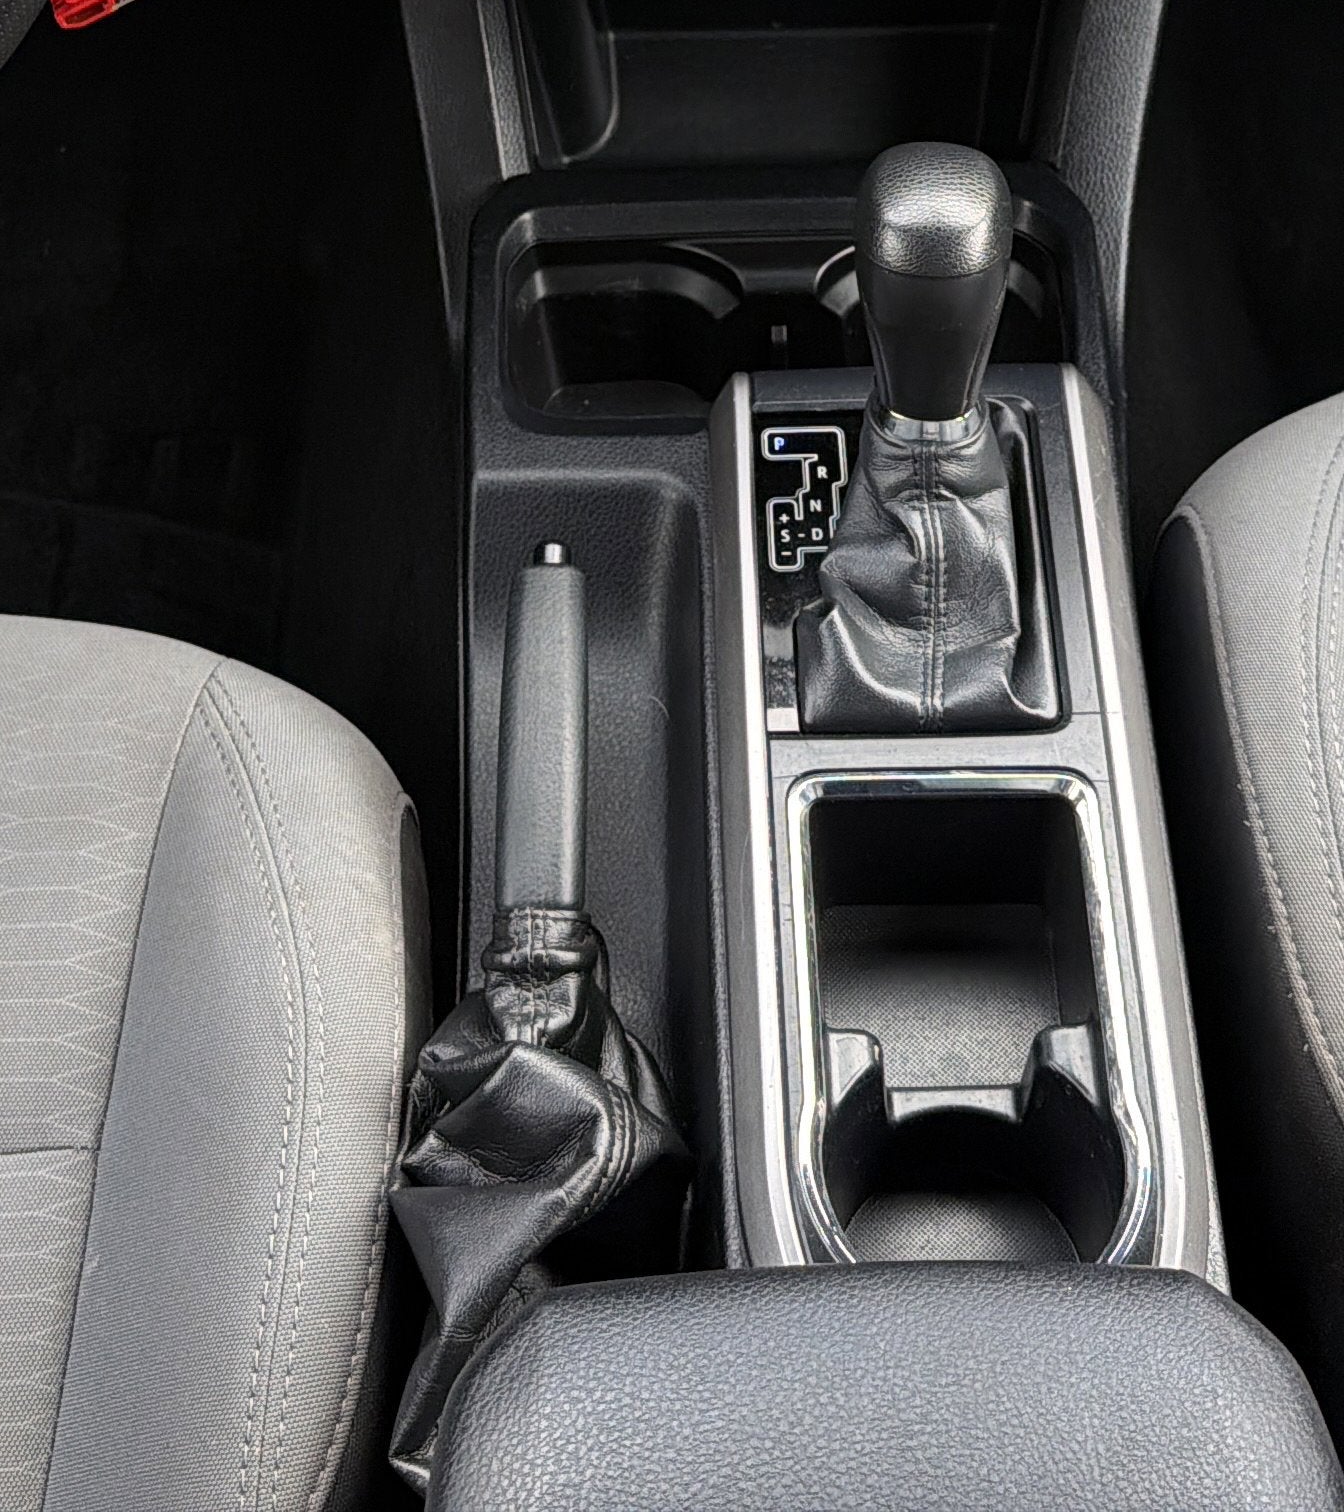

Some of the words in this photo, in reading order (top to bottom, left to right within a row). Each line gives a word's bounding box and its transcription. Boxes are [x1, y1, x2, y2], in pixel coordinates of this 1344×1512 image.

[774, 437, 785, 451] P
[817, 466, 828, 479] R
[810, 499, 822, 513] N
[781, 529, 791, 542] S
[811, 528, 823, 541] D
